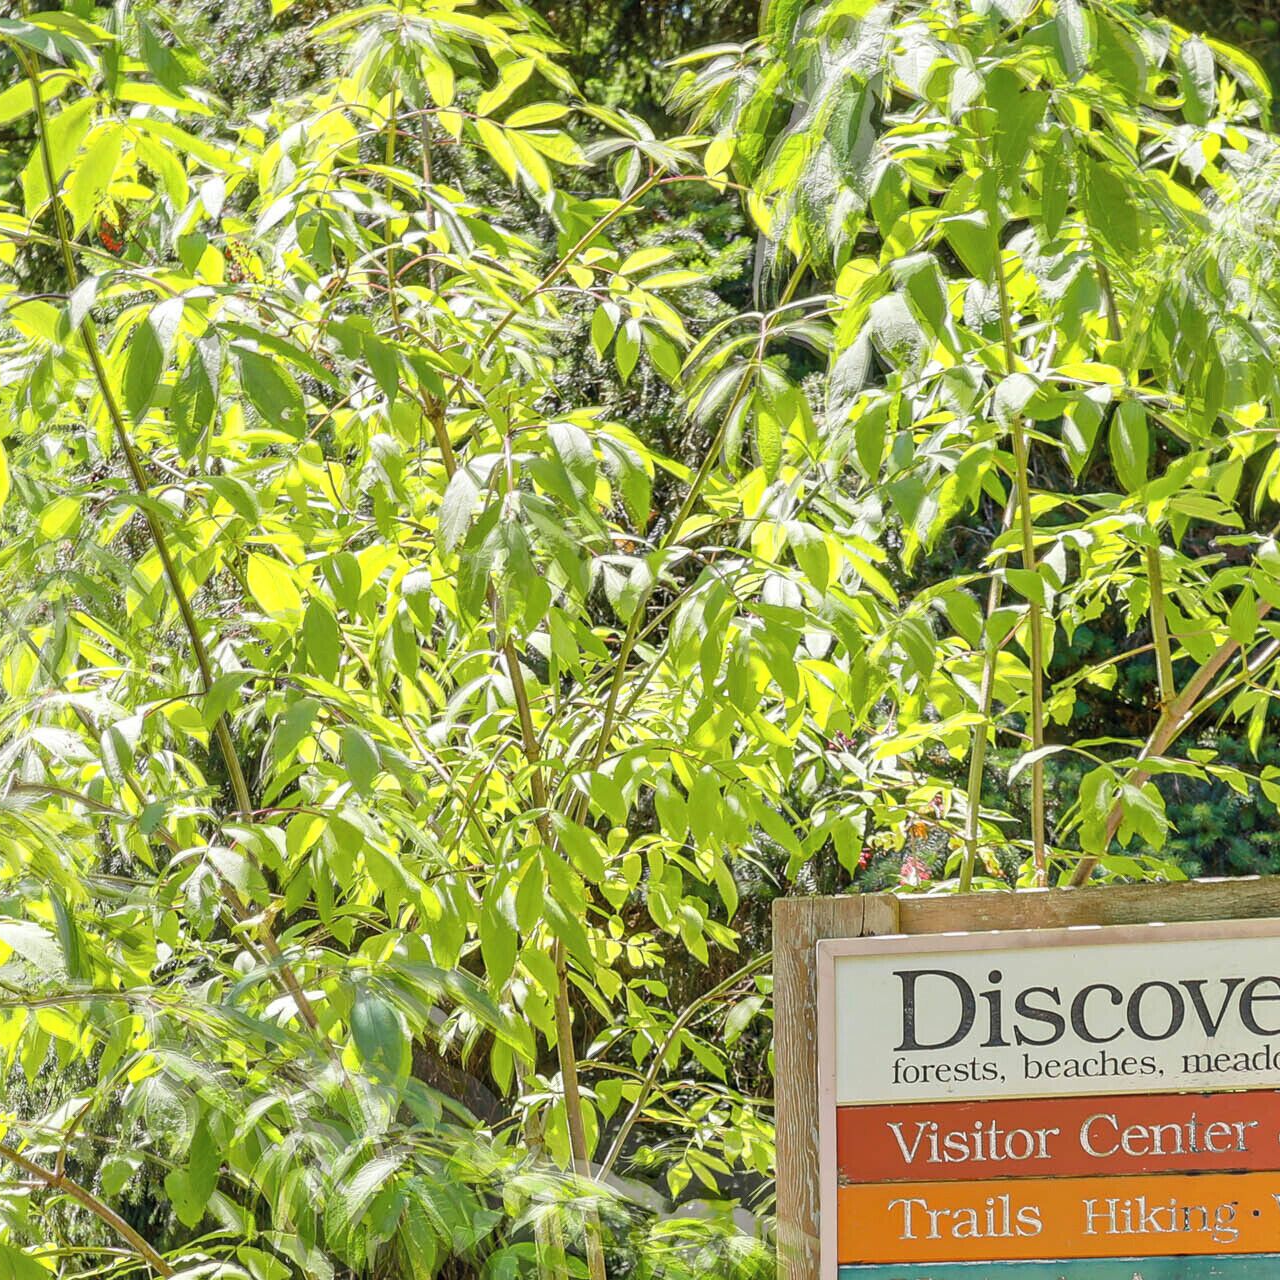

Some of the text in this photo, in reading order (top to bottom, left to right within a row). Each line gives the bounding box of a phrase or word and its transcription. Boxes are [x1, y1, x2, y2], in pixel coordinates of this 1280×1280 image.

[891, 1057, 1007, 1085] forests,
[1023, 1050, 1165, 1080] beaches,
[886, 1118, 1060, 1165] Visitor
[1079, 1112, 1259, 1157] Center
[887, 1193, 1045, 1241] Trails
[1081, 1195, 1242, 1245] Hiking
